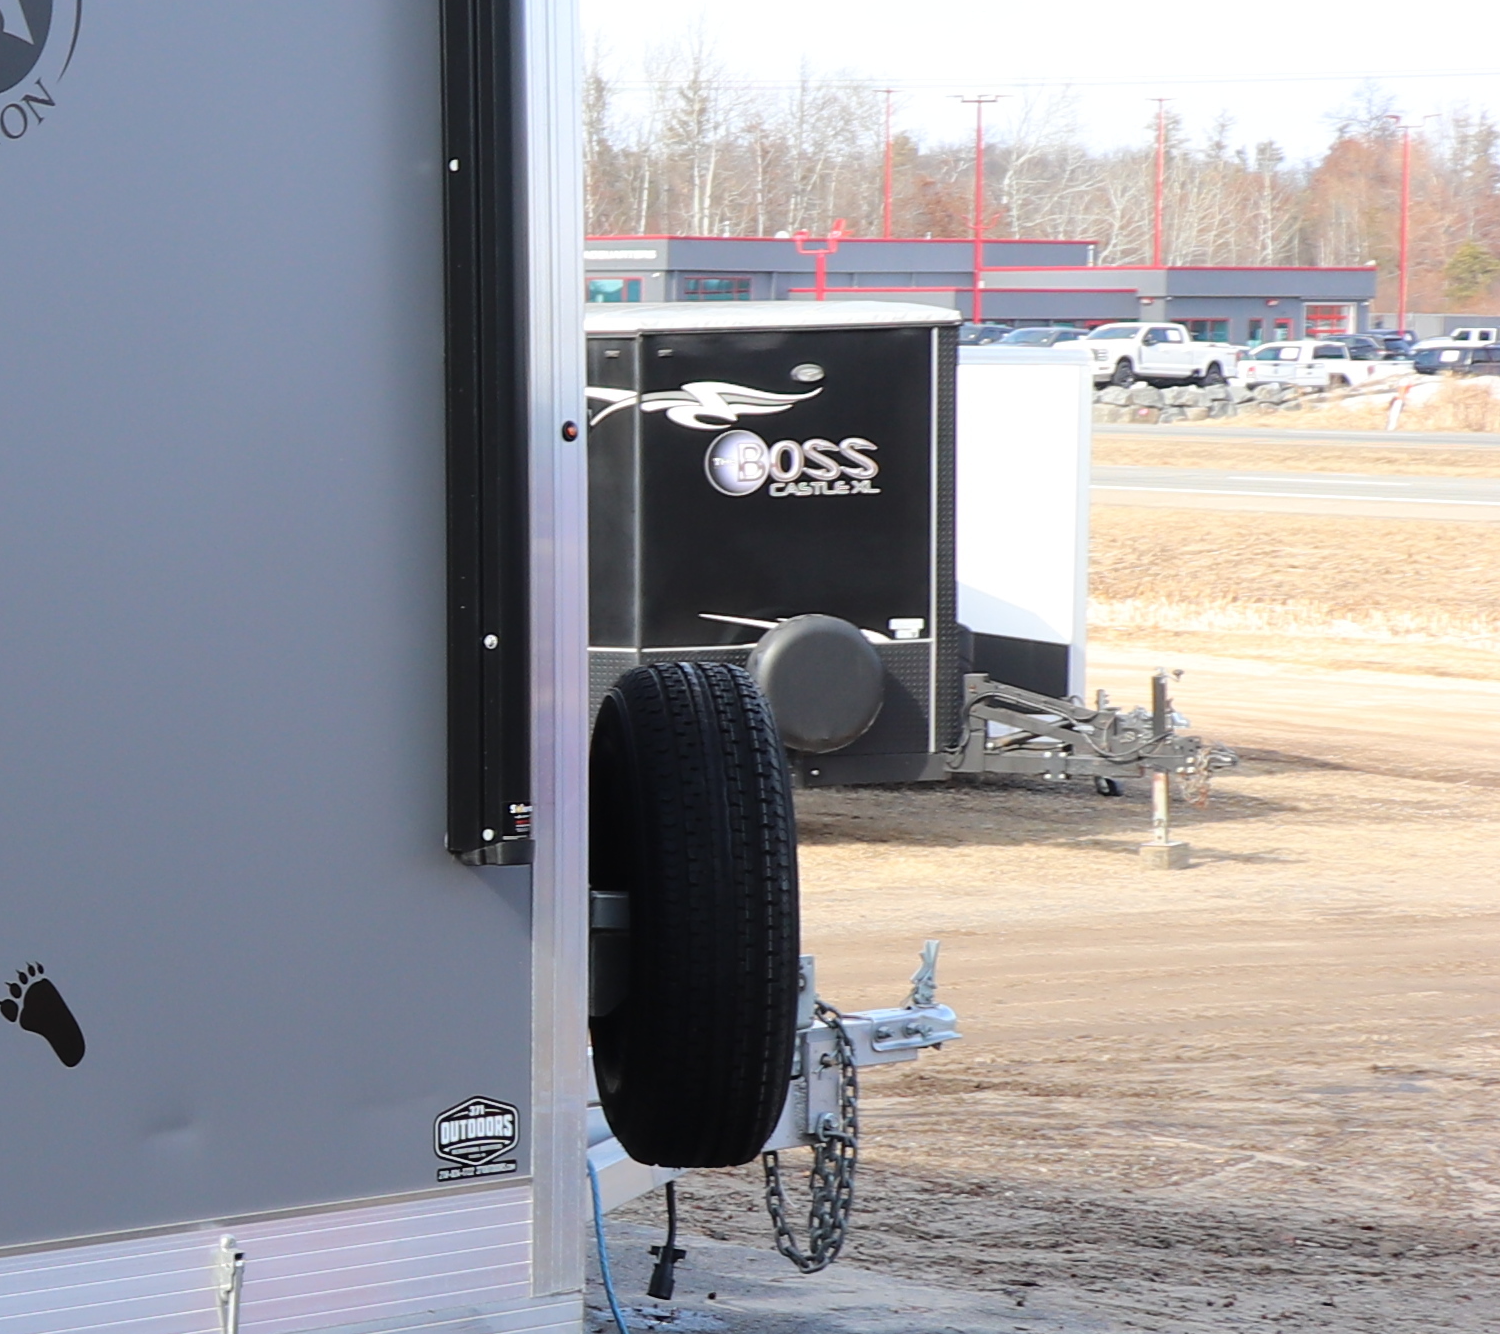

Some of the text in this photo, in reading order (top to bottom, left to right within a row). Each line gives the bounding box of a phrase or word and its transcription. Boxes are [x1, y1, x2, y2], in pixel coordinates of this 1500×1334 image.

[737, 437, 880, 481] BOSS
[769, 480, 881, 497] CASTLE XL
[468, 1104, 486, 1117] 371
[440, 1113, 514, 1146] OUTDOORS
